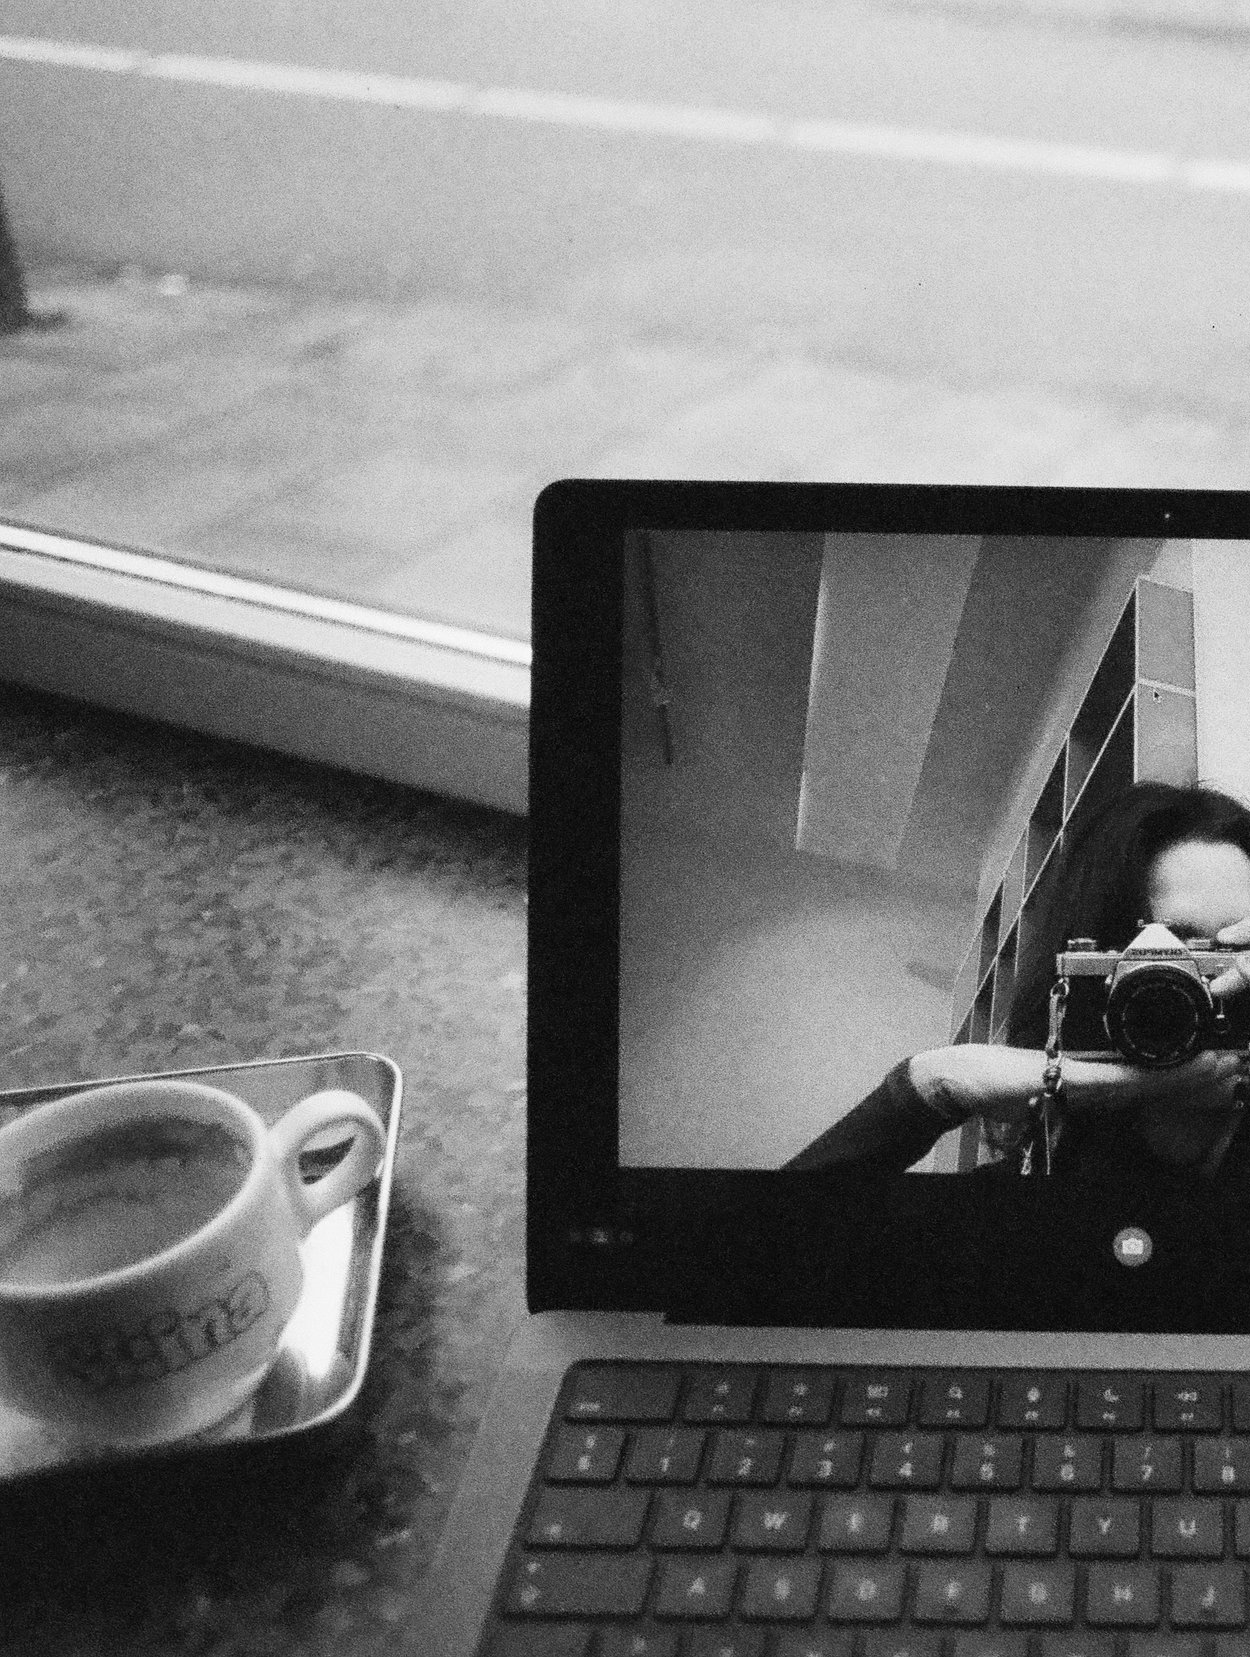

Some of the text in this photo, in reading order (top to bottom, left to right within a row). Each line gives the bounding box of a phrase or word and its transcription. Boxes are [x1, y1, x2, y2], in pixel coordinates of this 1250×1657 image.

[738, 1458, 752, 1475] 2
[899, 1462, 912, 1476] 4
[1142, 1465, 1153, 1480] 7
[684, 1511, 700, 1529] Q
[765, 1513, 785, 1529] W
[1099, 1519, 1111, 1533] Y
[1179, 1520, 1196, 1536] U
[1203, 1586, 1215, 1606] J
